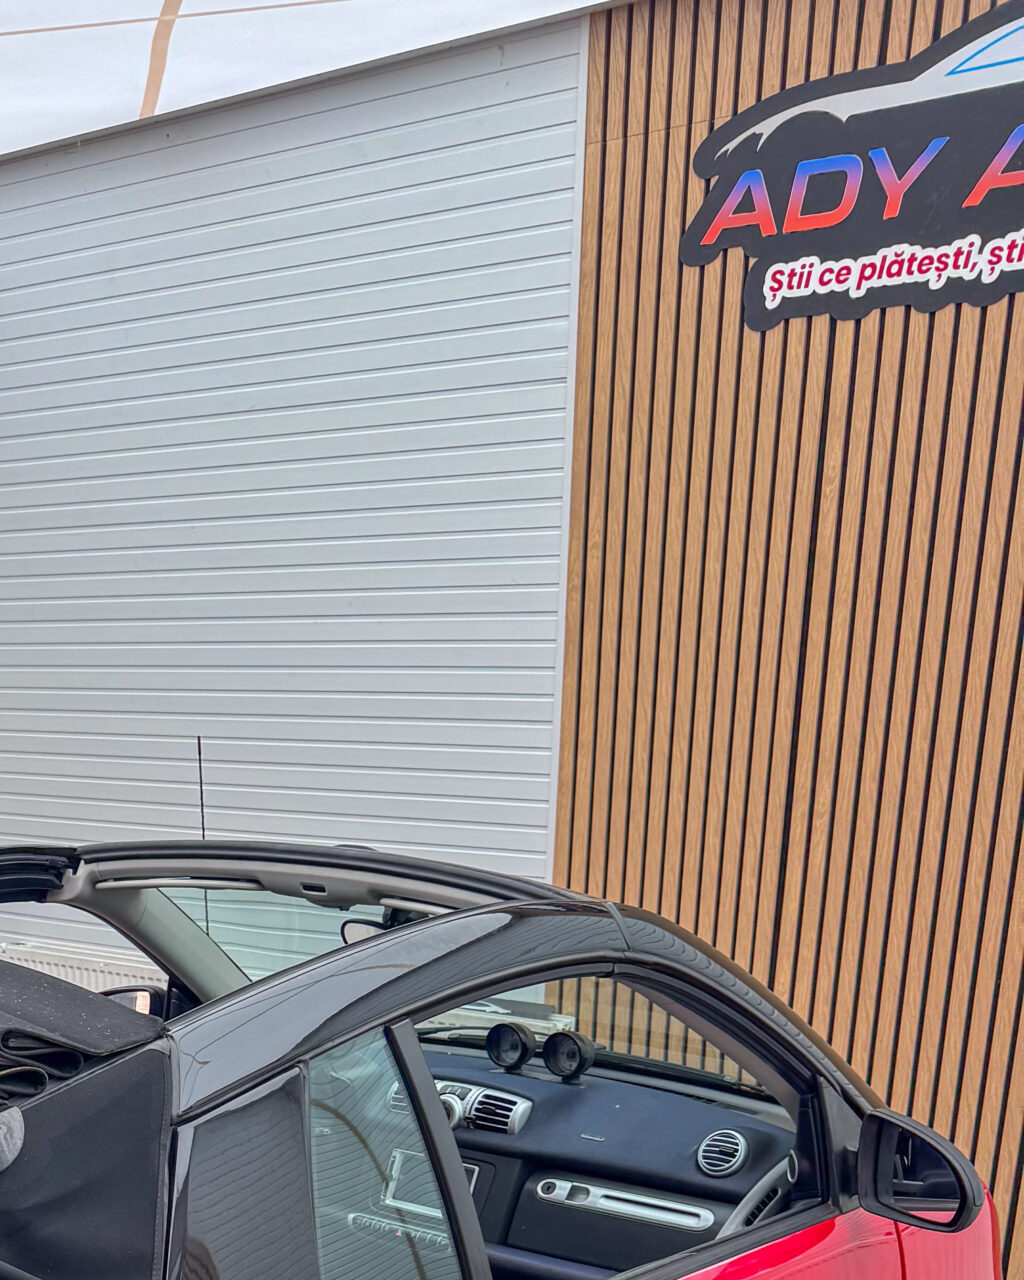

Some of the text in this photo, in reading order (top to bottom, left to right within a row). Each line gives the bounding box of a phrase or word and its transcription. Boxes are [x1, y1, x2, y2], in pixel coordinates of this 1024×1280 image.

[700, 137, 950, 245] ADY
[768, 262, 813, 302] Știi
[818, 264, 852, 287] ce
[855, 241, 979, 290] plătești,
